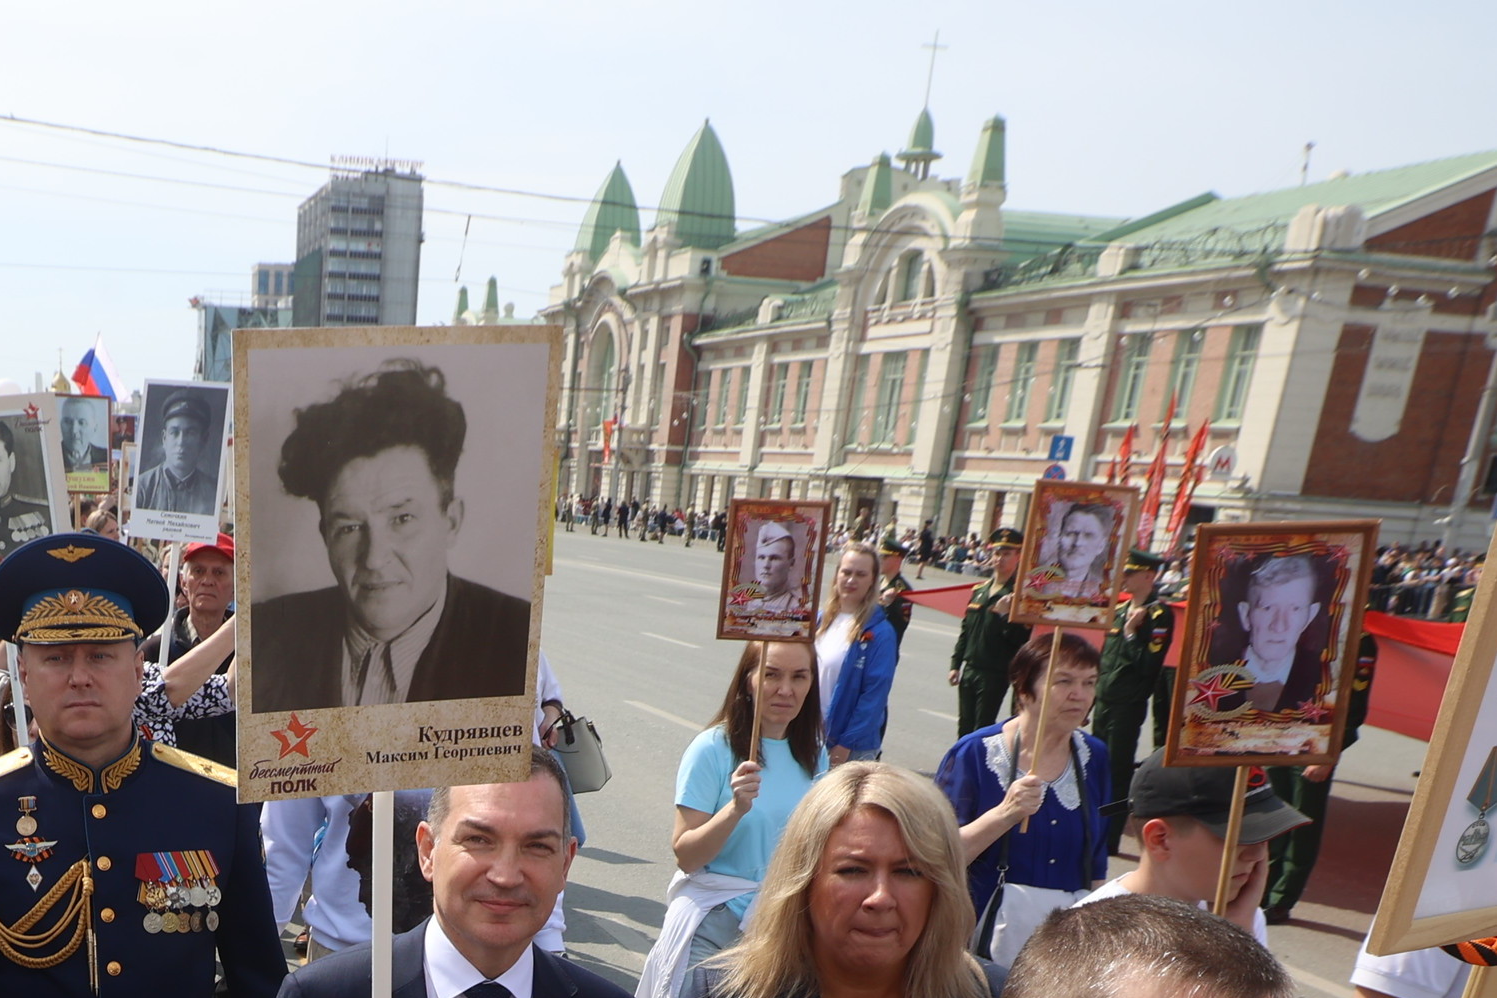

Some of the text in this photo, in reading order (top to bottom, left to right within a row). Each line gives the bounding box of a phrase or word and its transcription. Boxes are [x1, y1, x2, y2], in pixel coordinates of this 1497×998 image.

[417, 724, 524, 748] Кудрявцев
[365, 744, 523, 765] Максим Георгиевич
[249, 758, 343, 781] бессмертный
[270, 778, 318, 795] ПОЛК
